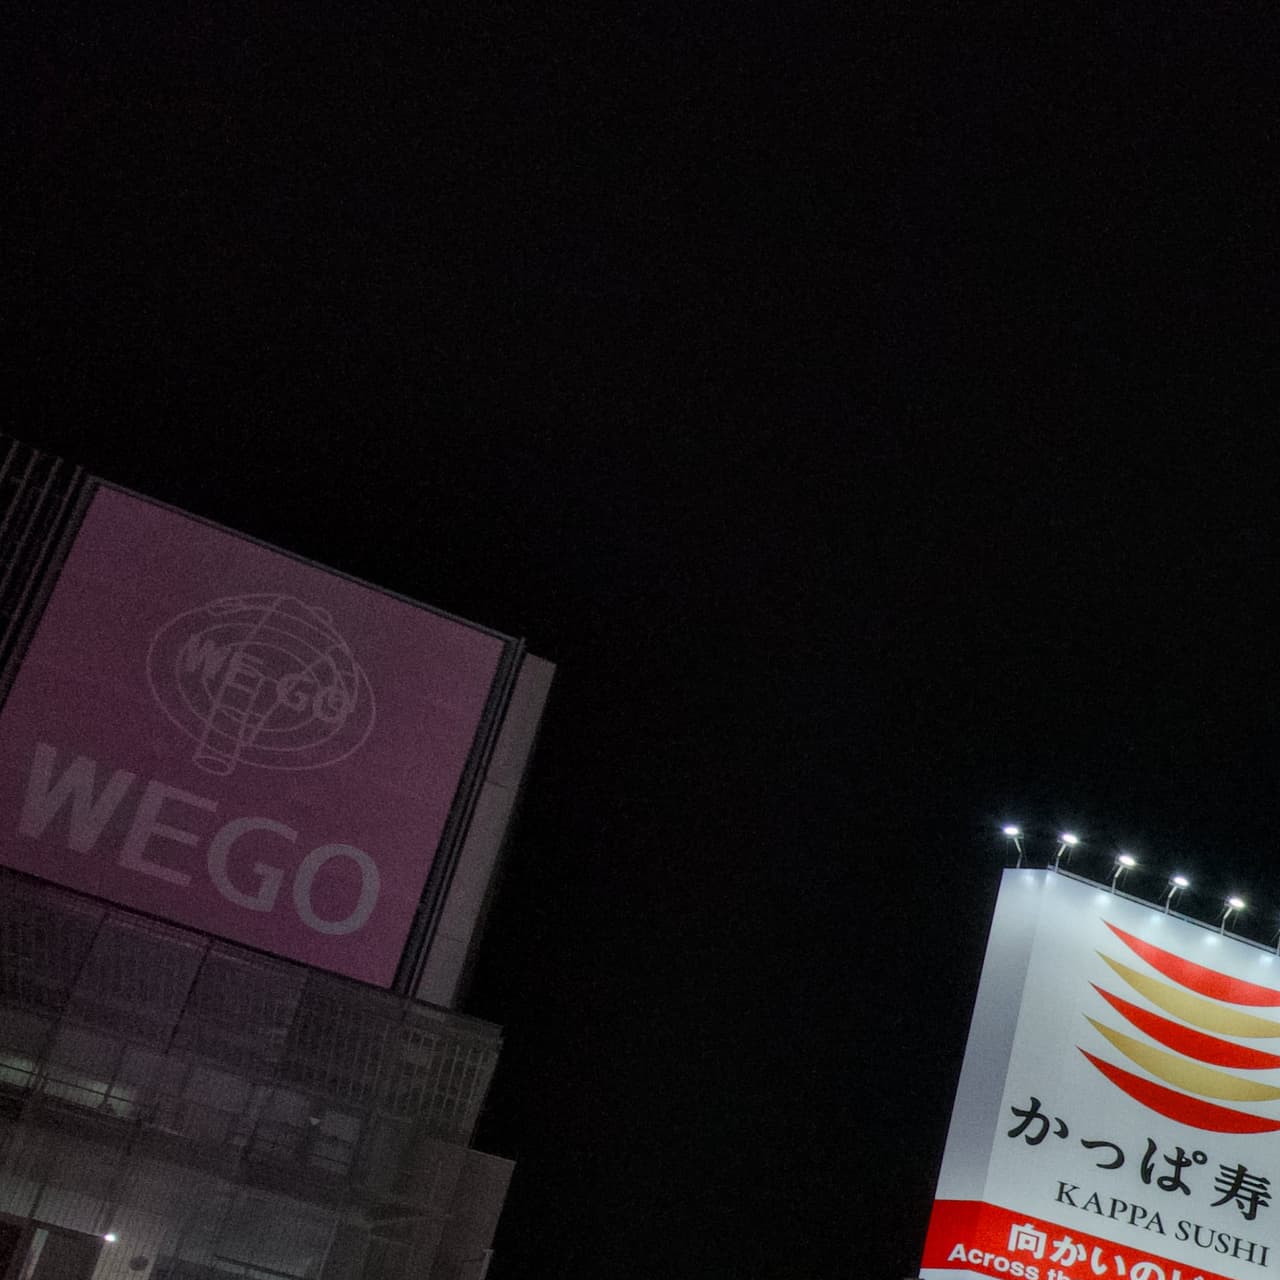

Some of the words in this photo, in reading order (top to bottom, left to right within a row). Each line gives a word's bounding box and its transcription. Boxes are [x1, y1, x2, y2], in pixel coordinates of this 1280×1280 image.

[16, 741, 382, 937] WEGO
[948, 1243, 1040, 1280] Across
[1056, 1180, 1165, 1235] KAPPA
[1175, 1220, 1271, 1267] SUSHI
